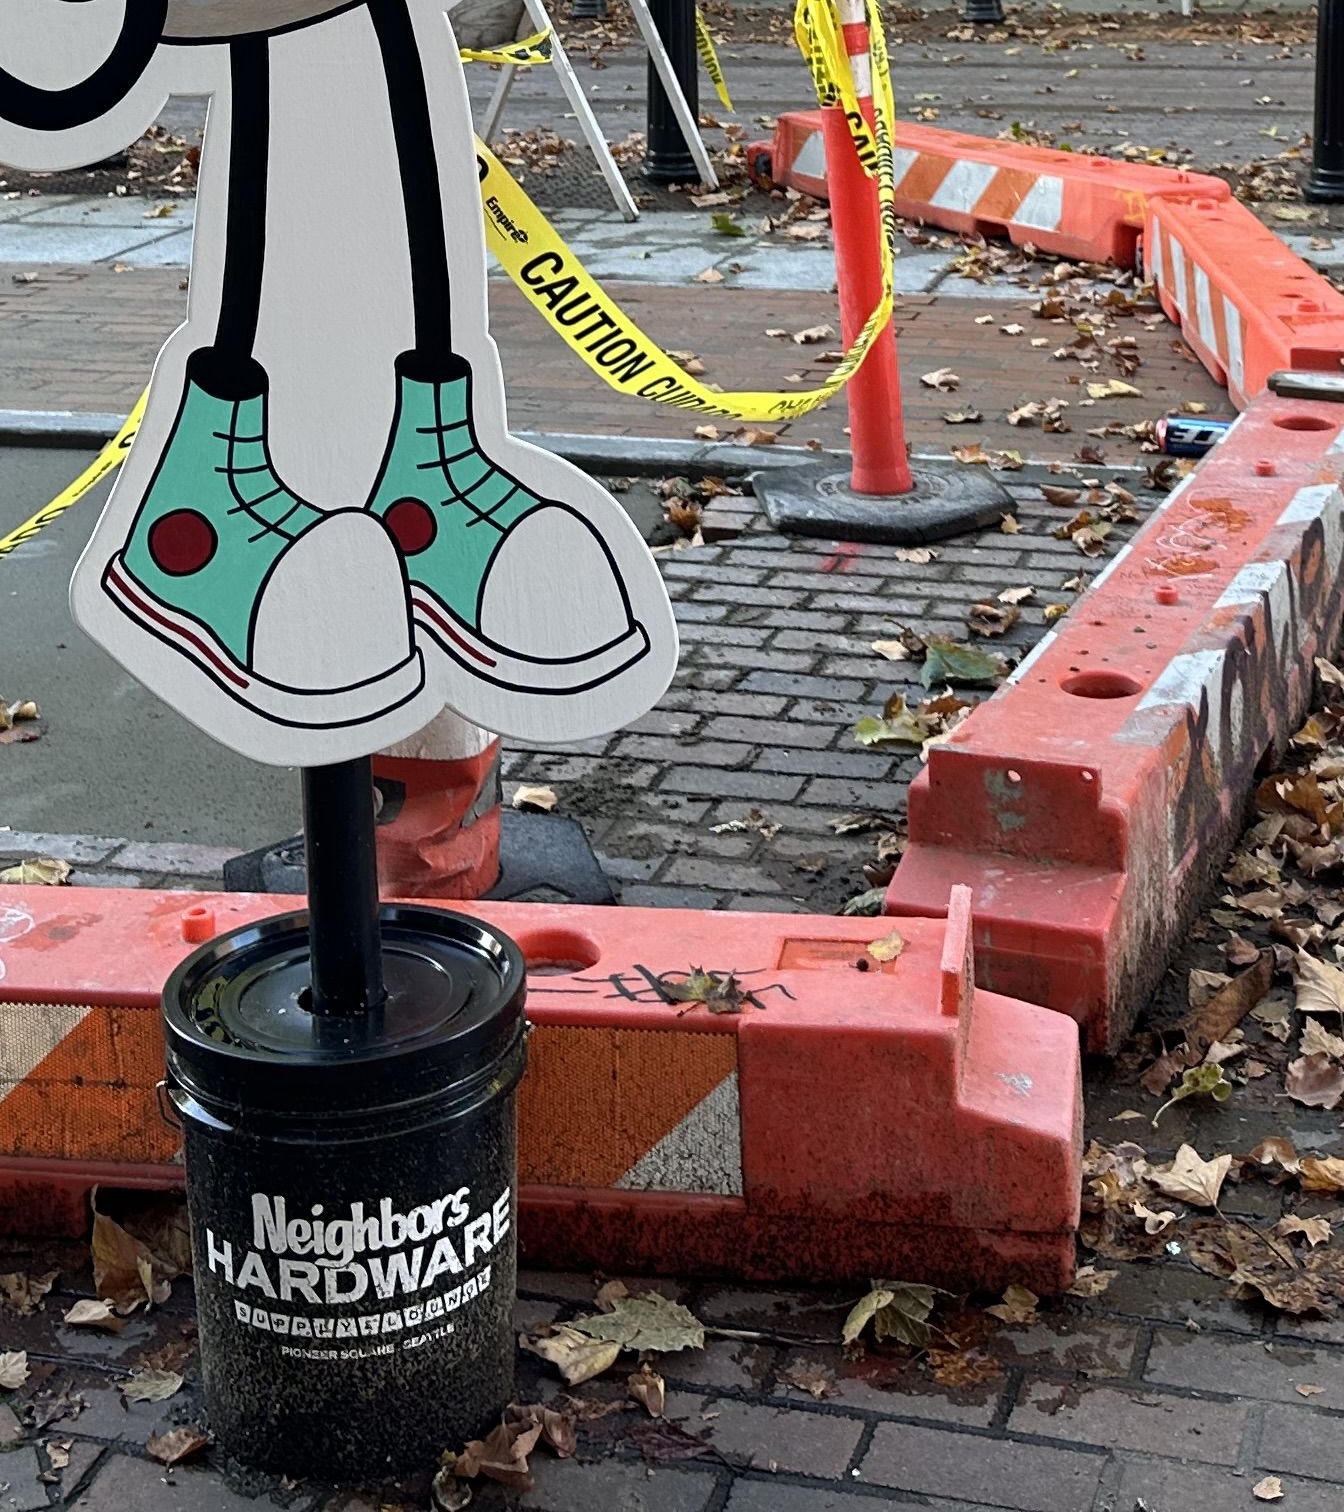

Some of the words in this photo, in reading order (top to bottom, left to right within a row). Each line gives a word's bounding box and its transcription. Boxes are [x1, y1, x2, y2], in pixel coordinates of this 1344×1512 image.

[485, 196, 523, 244] Empire
[520, 251, 657, 384] CAUTION
[206, 1185, 511, 1304] HARDWARE
[250, 1185, 470, 1267] Neighbors
[234, 1299, 359, 1338] SUPPLY
[281, 1346, 338, 1360] PIONEER
[341, 1343, 395, 1361] SQUARE
[403, 1323, 455, 1350] SEATTLE
